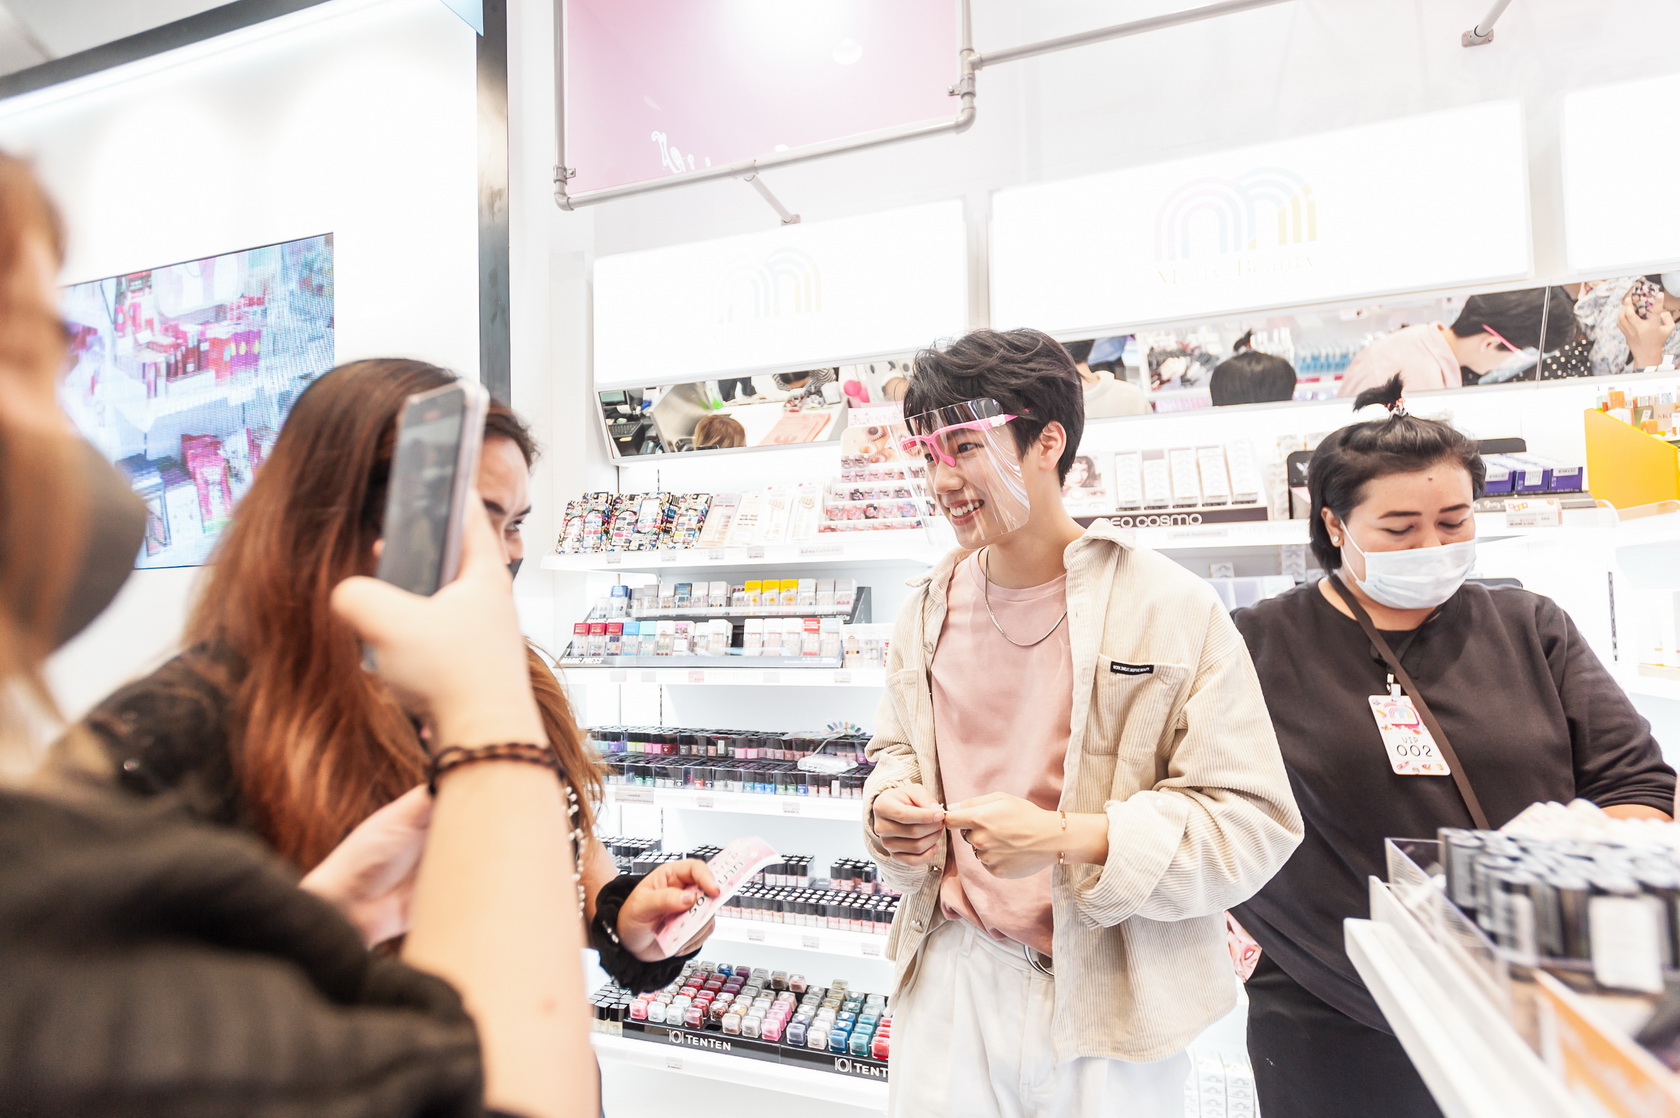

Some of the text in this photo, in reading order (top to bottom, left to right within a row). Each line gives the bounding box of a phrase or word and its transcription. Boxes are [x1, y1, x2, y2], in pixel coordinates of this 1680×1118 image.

[1401, 736, 1419, 744] VIP
[1396, 744, 1433, 758] 002
[685, 1034, 732, 1051] TENTEN
